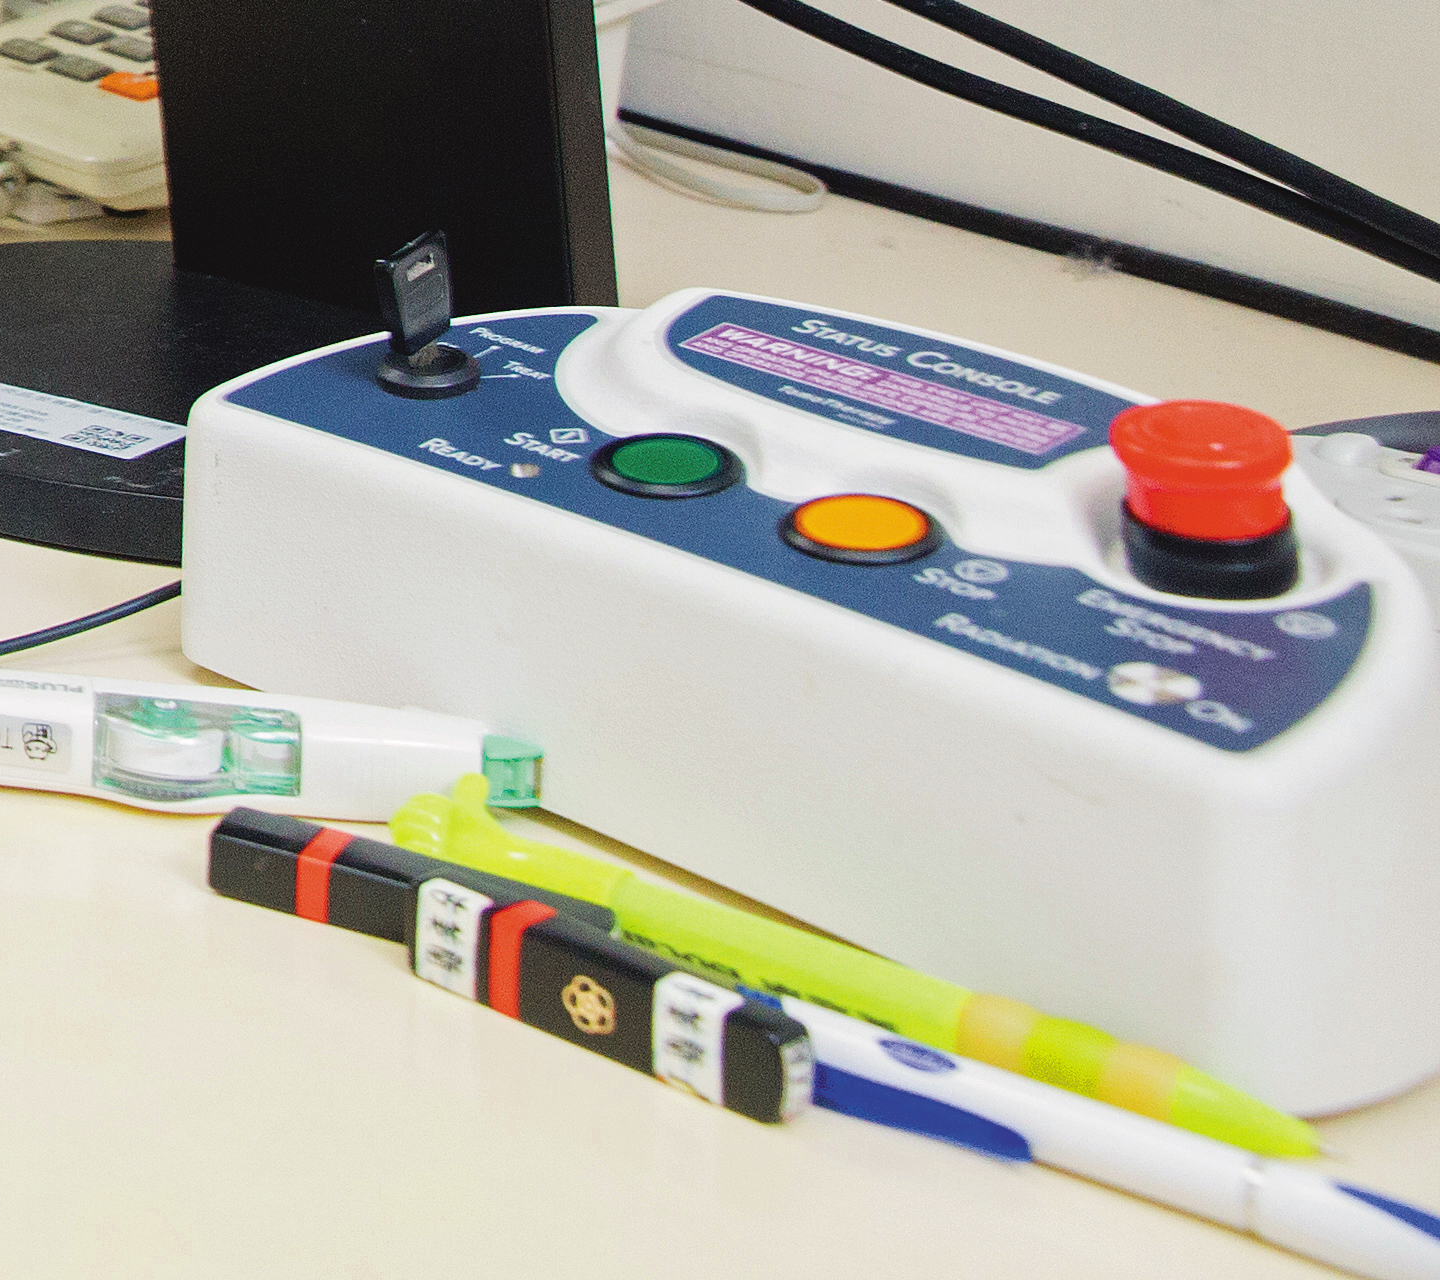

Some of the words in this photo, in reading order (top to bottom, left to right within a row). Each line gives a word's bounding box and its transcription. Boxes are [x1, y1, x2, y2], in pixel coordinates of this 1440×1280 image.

[791, 319, 901, 358] STATUS
[502, 360, 552, 380] TREAT
[719, 327, 880, 383] WARNING:
[418, 438, 503, 471] READY
[503, 432, 582, 462] START
[24, 679, 85, 695] PLUS
